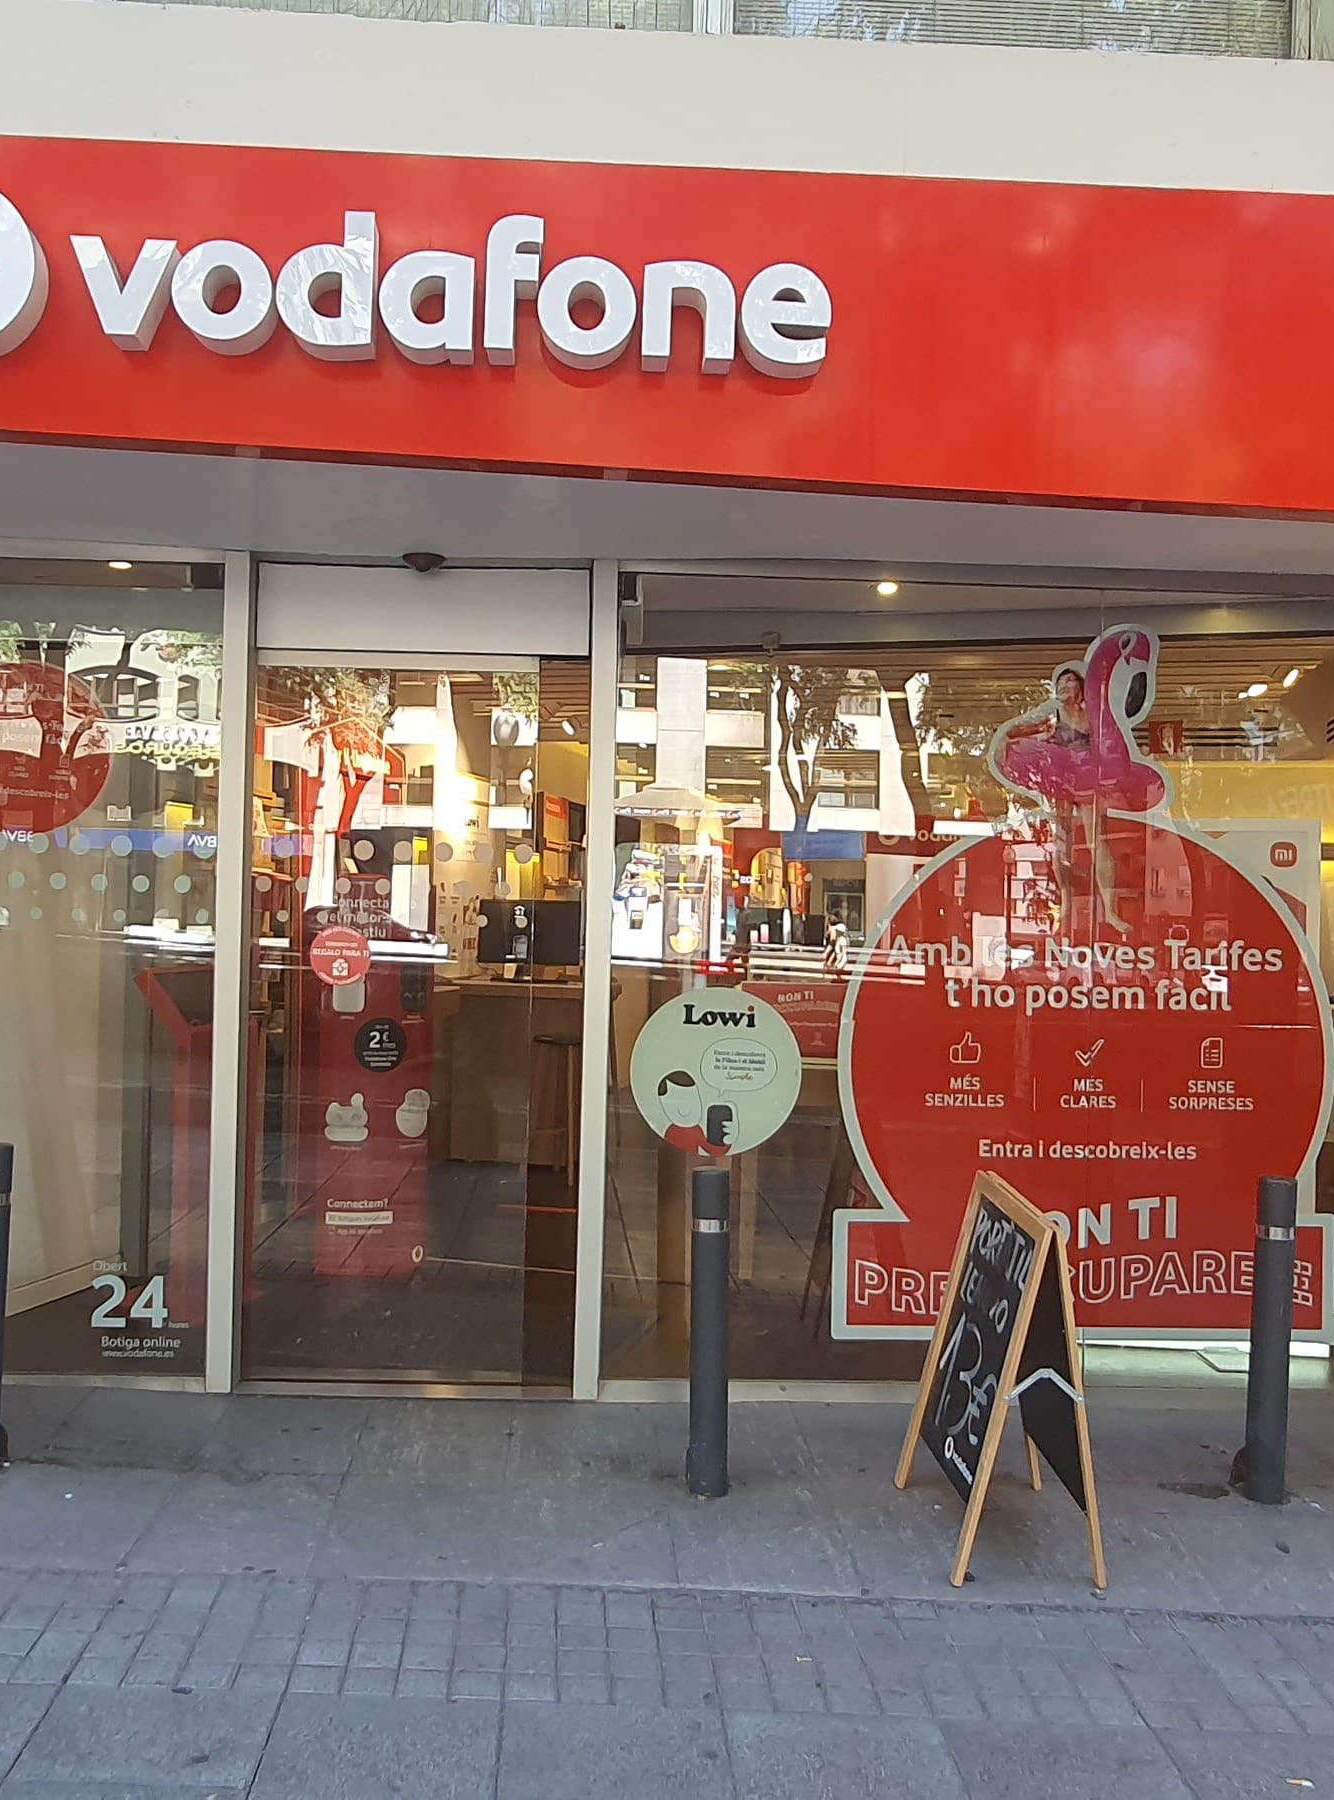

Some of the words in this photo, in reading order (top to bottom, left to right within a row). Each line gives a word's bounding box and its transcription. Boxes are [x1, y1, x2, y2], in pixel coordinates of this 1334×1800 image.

[69, 210, 833, 378] vodafone
[338, 898, 389, 909] onnecta
[886, 935, 972, 966] Amb
[1045, 936, 1155, 969] Noves
[1163, 940, 1283, 972] Tarifes
[1025, 983, 1145, 1017] posem
[1155, 977, 1232, 1012] fàcil
[683, 1004, 756, 1028] Lowi
[950, 1074, 981, 1090] MÉS
[1073, 1075, 1104, 1092] MÉS
[1187, 1080, 1236, 1094] SENSE
[924, 1093, 1005, 1107] SENZILLES
[1060, 1095, 1116, 1109] CLARES
[1168, 1096, 1254, 1111] SORPRESES
[978, 1138, 1033, 1159] Entra
[1038, 1139, 1044, 1158] i
[1049, 1139, 1197, 1161] descobreix-les
[1043, 1203, 1112, 1250] ON
[1128, 1196, 1178, 1240] TI
[92, 1260, 128, 1273] Obert
[91, 1274, 168, 1329] 24
[101, 1336, 140, 1350] Botiga
[142, 1336, 181, 1348] online
